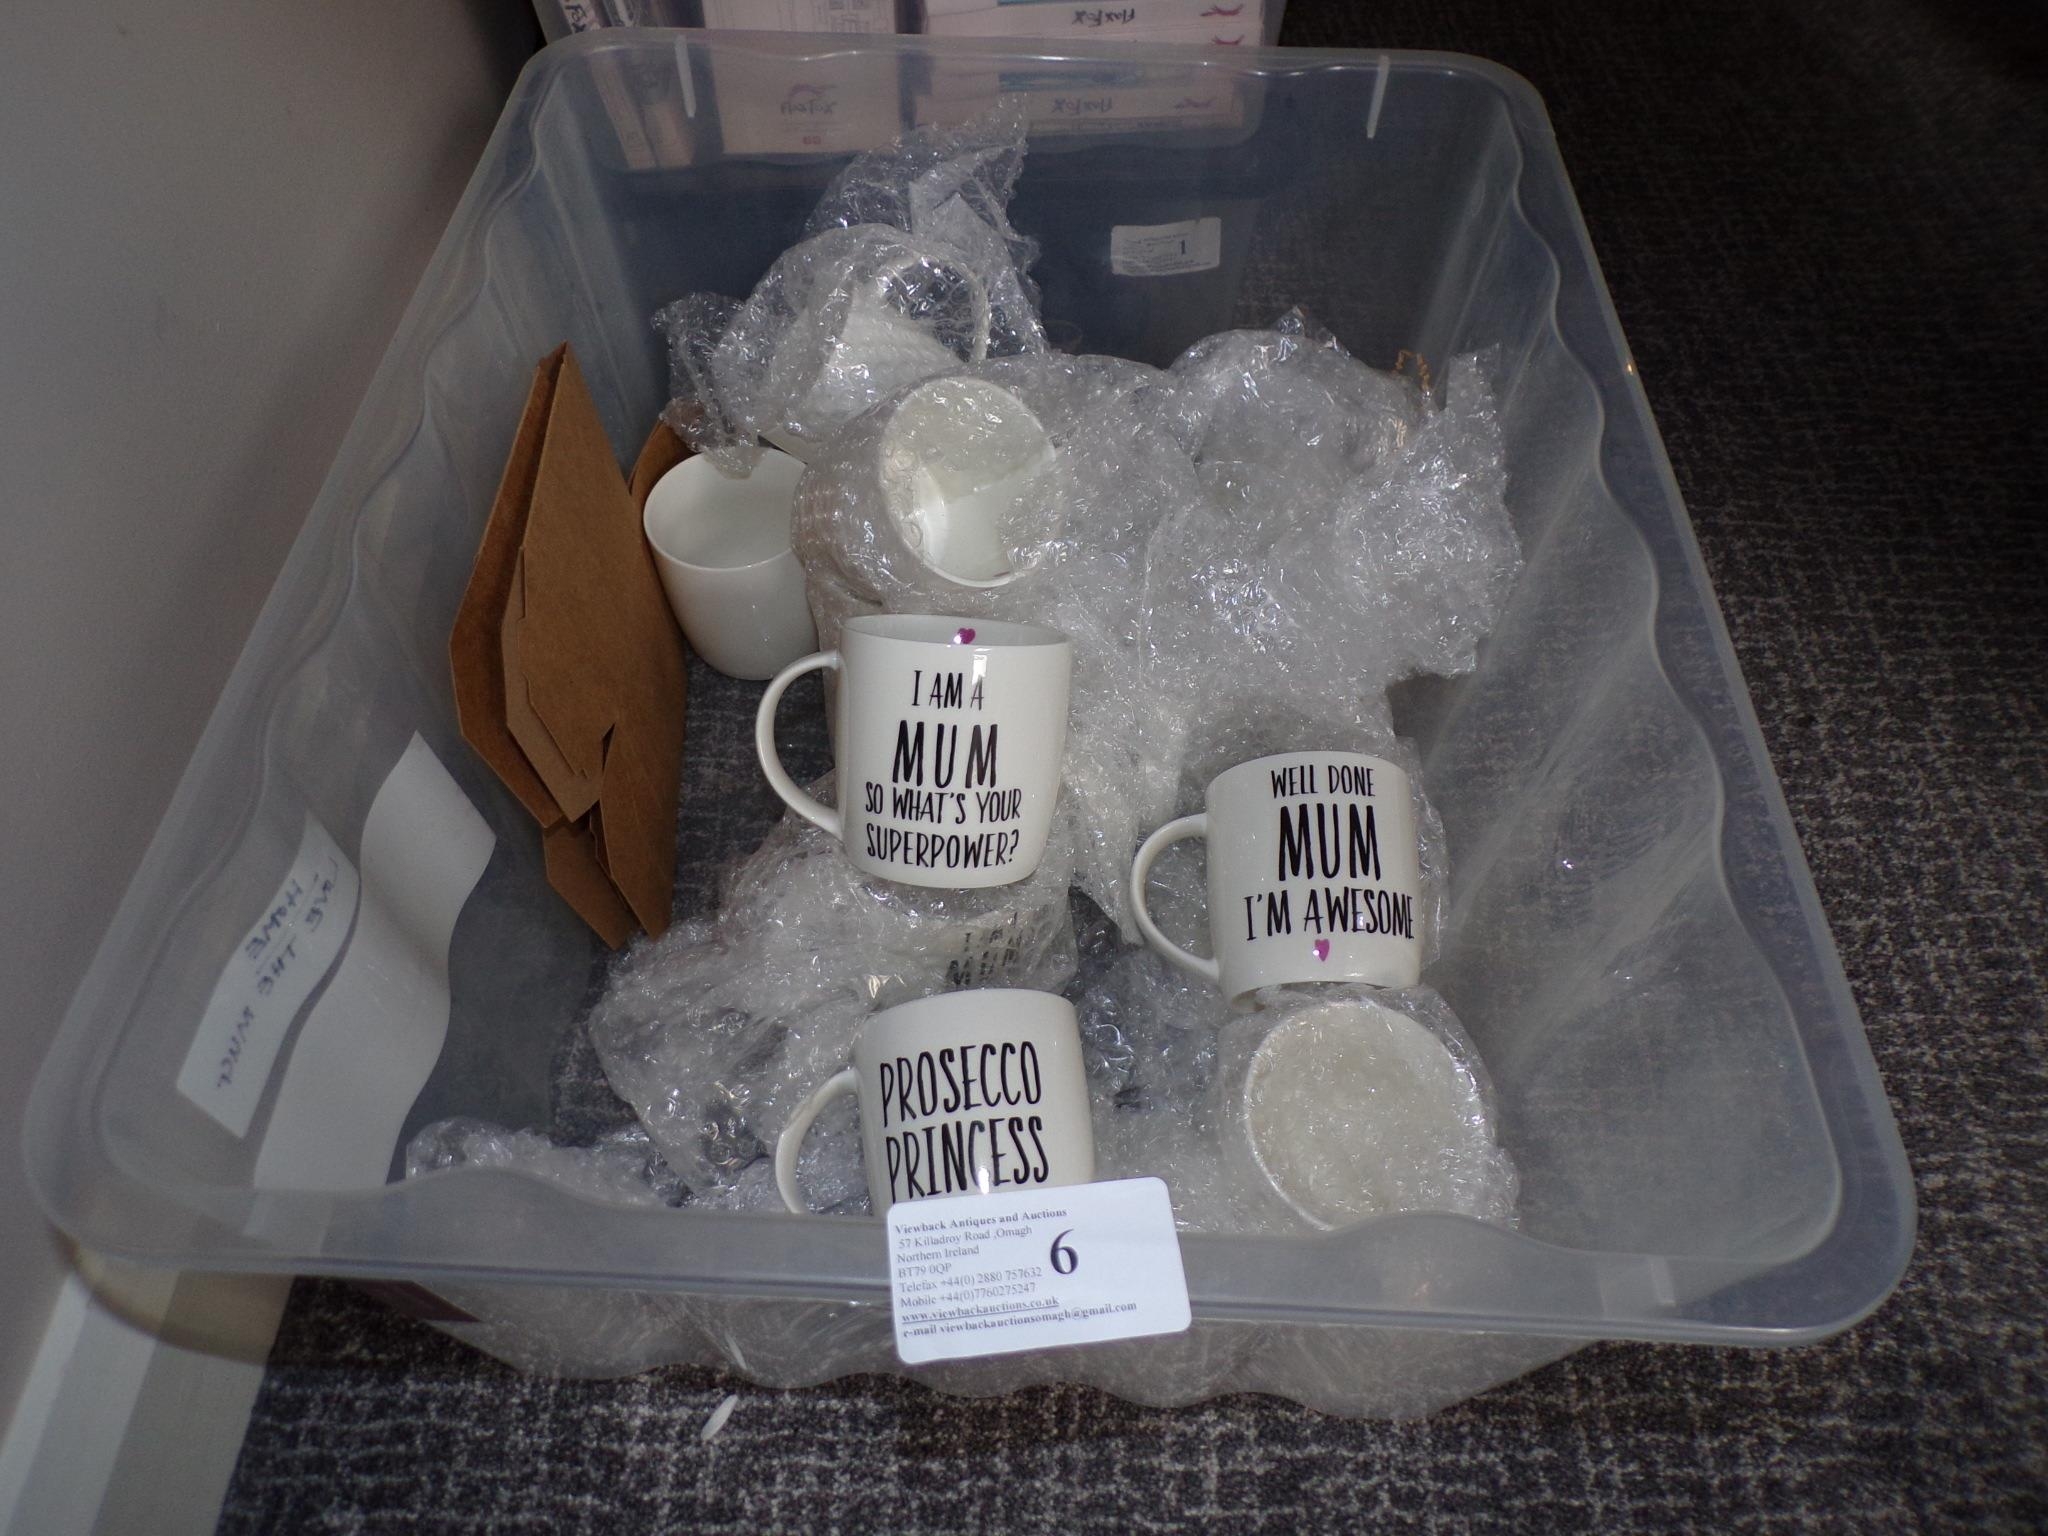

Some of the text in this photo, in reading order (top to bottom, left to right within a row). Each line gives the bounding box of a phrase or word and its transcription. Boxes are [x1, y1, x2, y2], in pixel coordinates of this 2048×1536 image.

[911, 669, 985, 711] I AM A
[892, 719, 999, 789] MUM
[1271, 764, 1376, 799] WELL DONE
[865, 781, 1022, 825] SO WHAT'S YOUR
[866, 822, 1020, 869] SUPERPOWER?
[1278, 803, 1381, 882] MUM
[1244, 886, 1415, 942] I'M AWESOME
[880, 1041, 1042, 1128] PROSECCO
[885, 1115, 1049, 1204] PRINCESS
[894, 1208, 1068, 1235] Viewback Antiques and Auctions
[965, 1230, 990, 1241] Road
[945, 1244, 980, 1258] Ireland
[1050, 1228, 1079, 1275] 6
[898, 1266, 927, 1279] BT79
[900, 1281, 938, 1293] Telefax
[977, 1271, 1003, 1284] 2880
[1005, 1267, 1042, 1281] 757632
[901, 1295, 937, 1308] Mobile
[902, 1296, 1060, 1324] www.viewbackauctions.co.uk
[903, 1325, 937, 1338] e-mail
